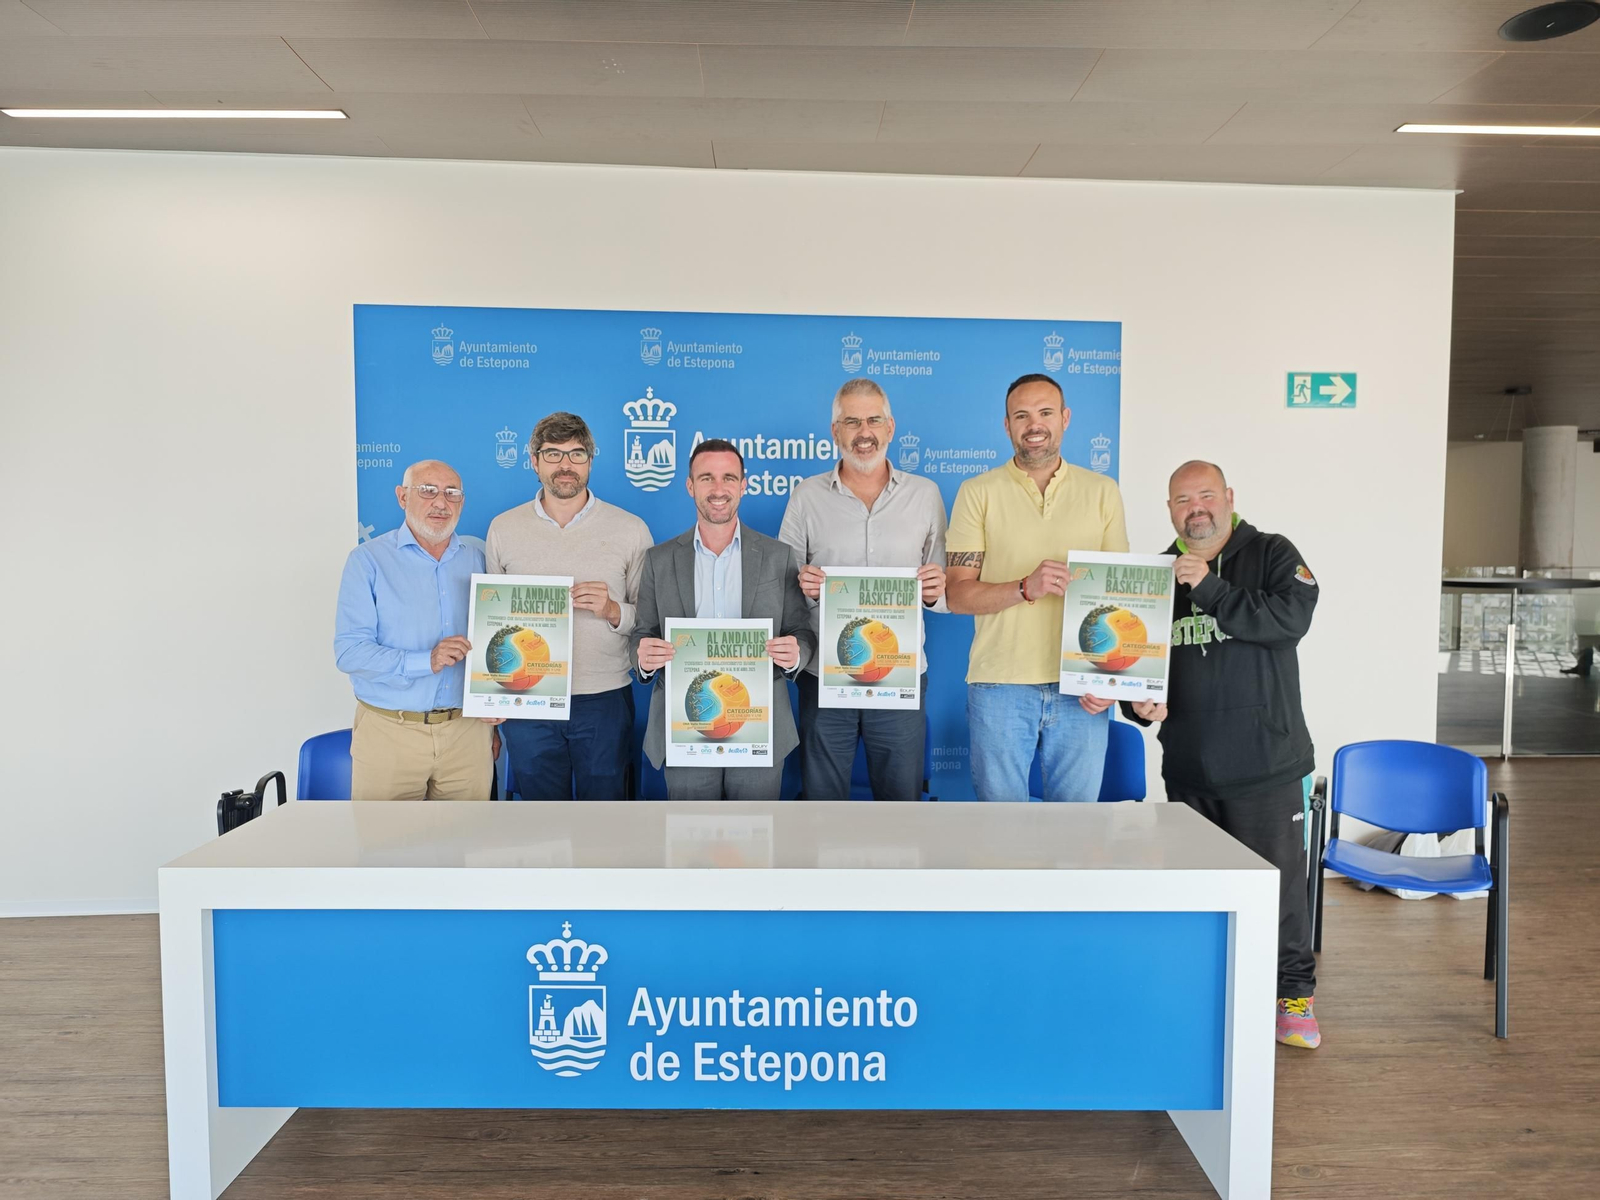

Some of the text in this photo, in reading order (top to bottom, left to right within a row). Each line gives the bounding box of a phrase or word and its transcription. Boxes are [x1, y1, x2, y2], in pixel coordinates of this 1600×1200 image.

[459, 341, 538, 354] Ayuntamiento
[667, 341, 743, 355] Ayuntamiento
[867, 348, 941, 362] Ayuntamiento
[460, 356, 530, 370] de Estepona
[667, 356, 735, 370] de Estepona
[867, 363, 933, 377] de Estepona
[1067, 362, 1081, 374] de
[924, 447, 997, 461] Ayuntamiento
[924, 462, 989, 475] de Estepona
[1106, 566, 1169, 582] AL ANDALUS
[859, 579, 915, 592] AL ANDALUS
[1105, 580, 1168, 596] BASKET CUP
[511, 587, 566, 601] AL ANDALUS
[859, 592, 914, 606] BASKET CUP
[511, 600, 566, 615] BASKET CUP
[707, 631, 766, 645] AL ANDALUS
[707, 644, 766, 658] BASKET CUP
[931, 745, 969, 756] miento
[627, 987, 918, 1036] Ayuntamiento
[630, 1042, 887, 1090] de Estepona
